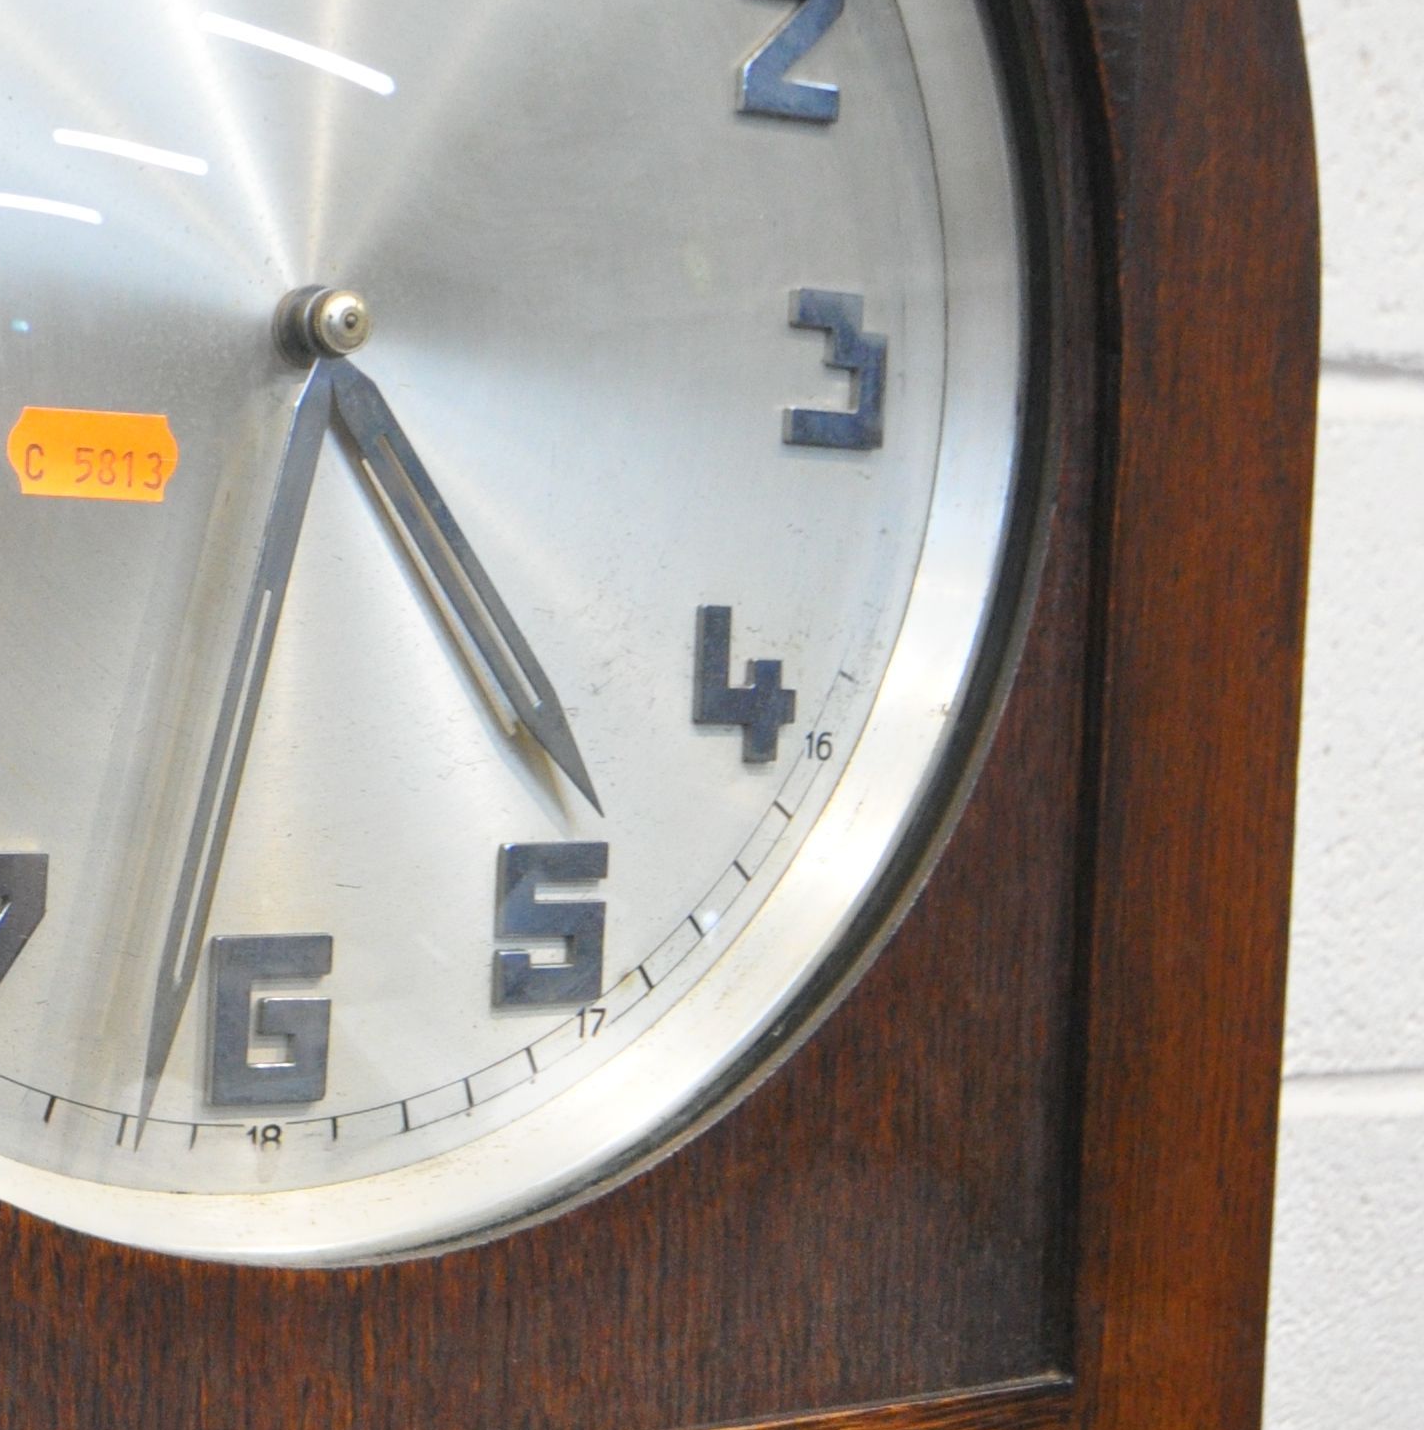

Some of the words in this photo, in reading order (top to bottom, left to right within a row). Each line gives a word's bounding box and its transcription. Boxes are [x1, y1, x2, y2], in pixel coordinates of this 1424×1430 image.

[783, 287, 888, 450] 3
[25, 443, 45, 480] C
[75, 447, 163, 490] 5813
[693, 605, 796, 763] 4
[805, 730, 833, 761] 16
[492, 841, 609, 1010] 5
[208, 934, 333, 1105] 6
[576, 1005, 606, 1038] 17
